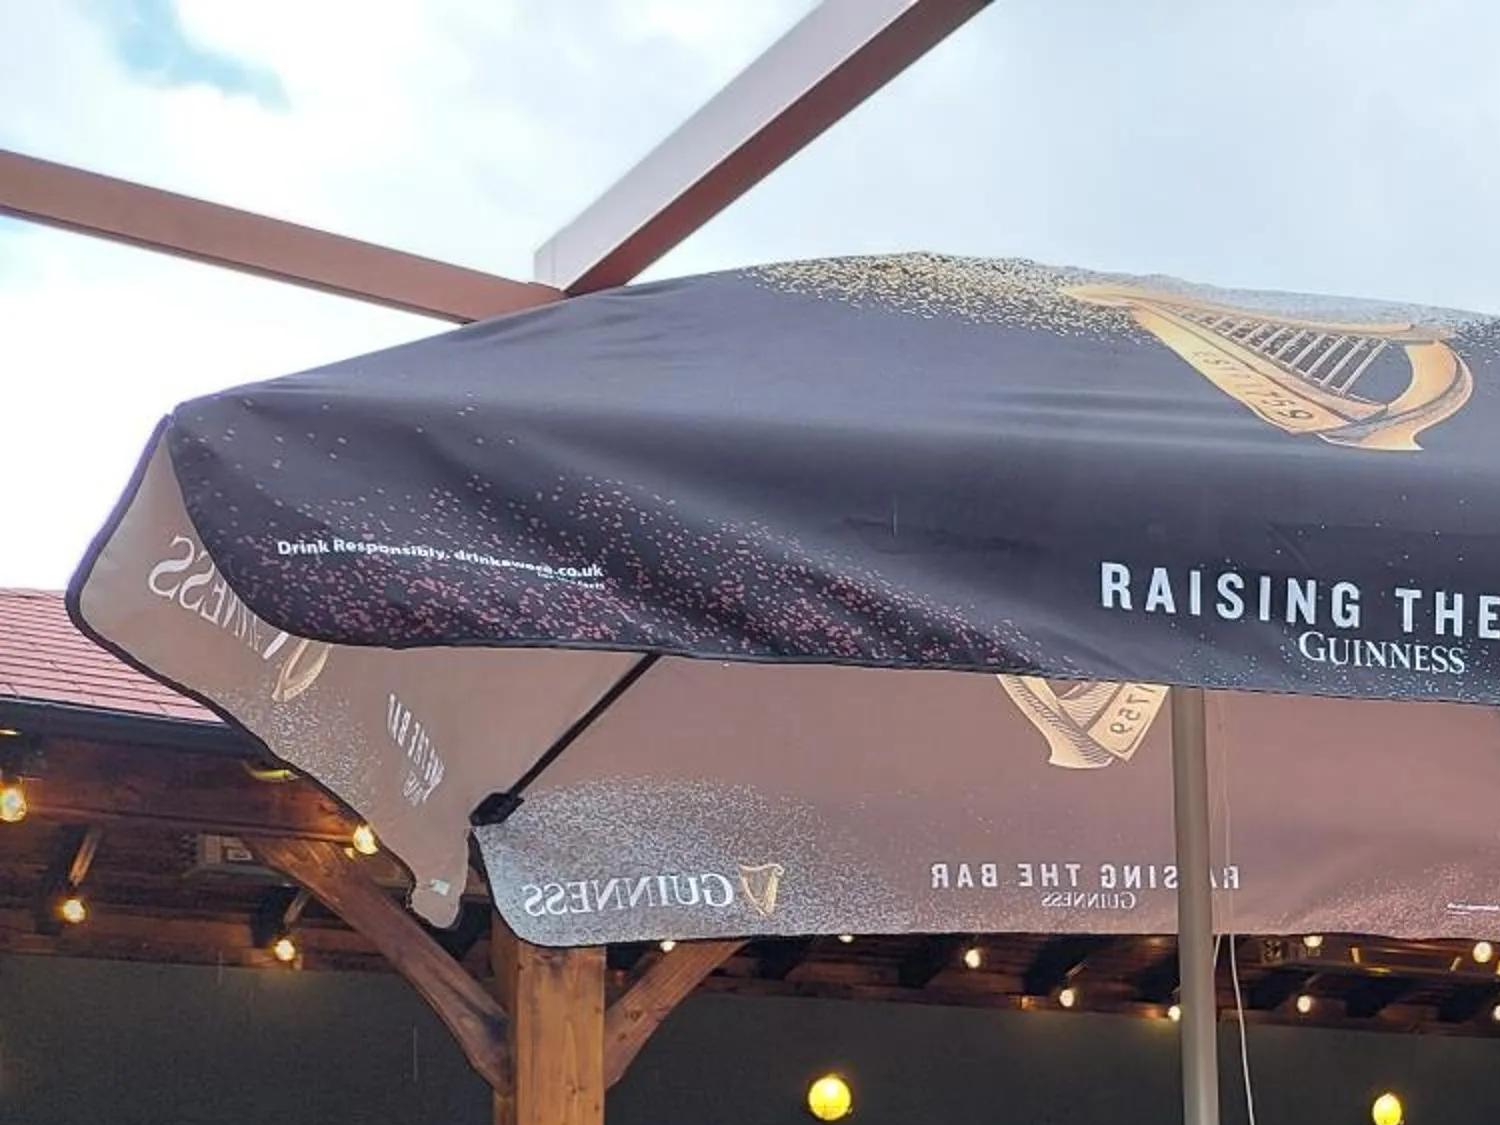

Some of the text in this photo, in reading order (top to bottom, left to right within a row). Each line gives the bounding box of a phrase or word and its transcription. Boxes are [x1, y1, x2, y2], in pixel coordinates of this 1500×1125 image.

[277, 539, 330, 556] Drink
[1101, 561, 1361, 629] RAISING
[1299, 630, 1465, 674] GUINNESS
